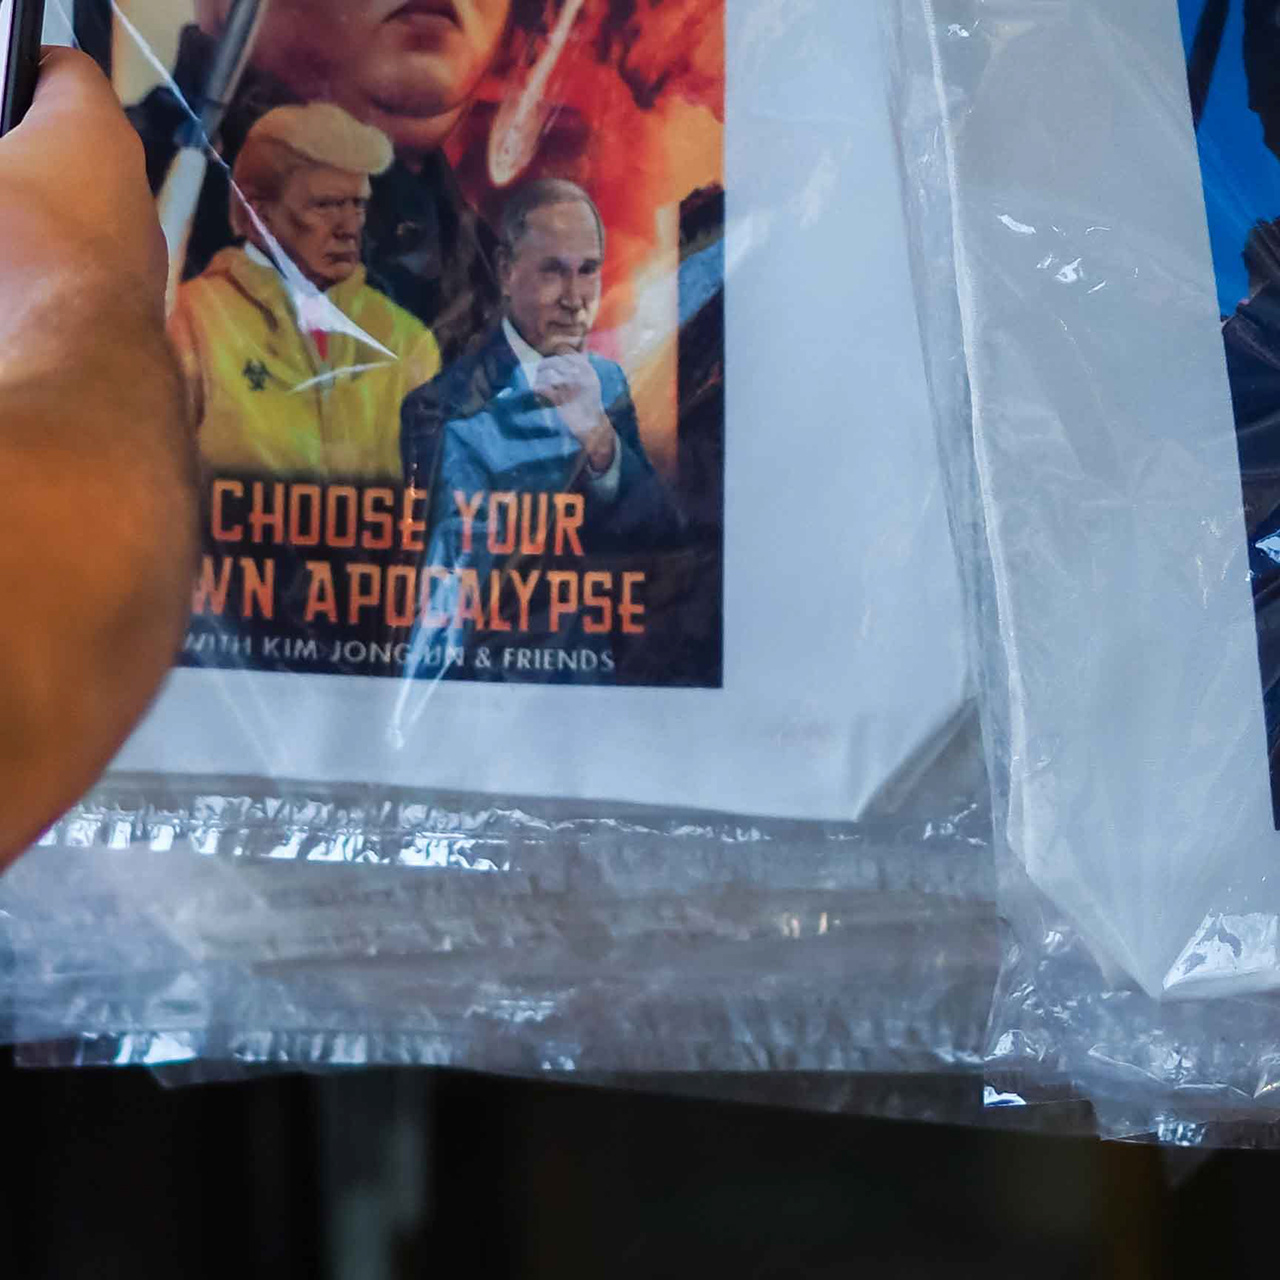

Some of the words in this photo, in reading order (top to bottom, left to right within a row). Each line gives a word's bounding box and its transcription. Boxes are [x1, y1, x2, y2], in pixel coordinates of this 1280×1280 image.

[211, 479, 427, 551] CHOOSE
[453, 489, 586, 557] YOUR
[191, 555, 275, 618] WN
[304, 560, 646, 634] APOCALYPSE
[260, 636, 318, 660] KIM
[474, 647, 492, 669] &
[502, 647, 616, 671] FRIENDS
